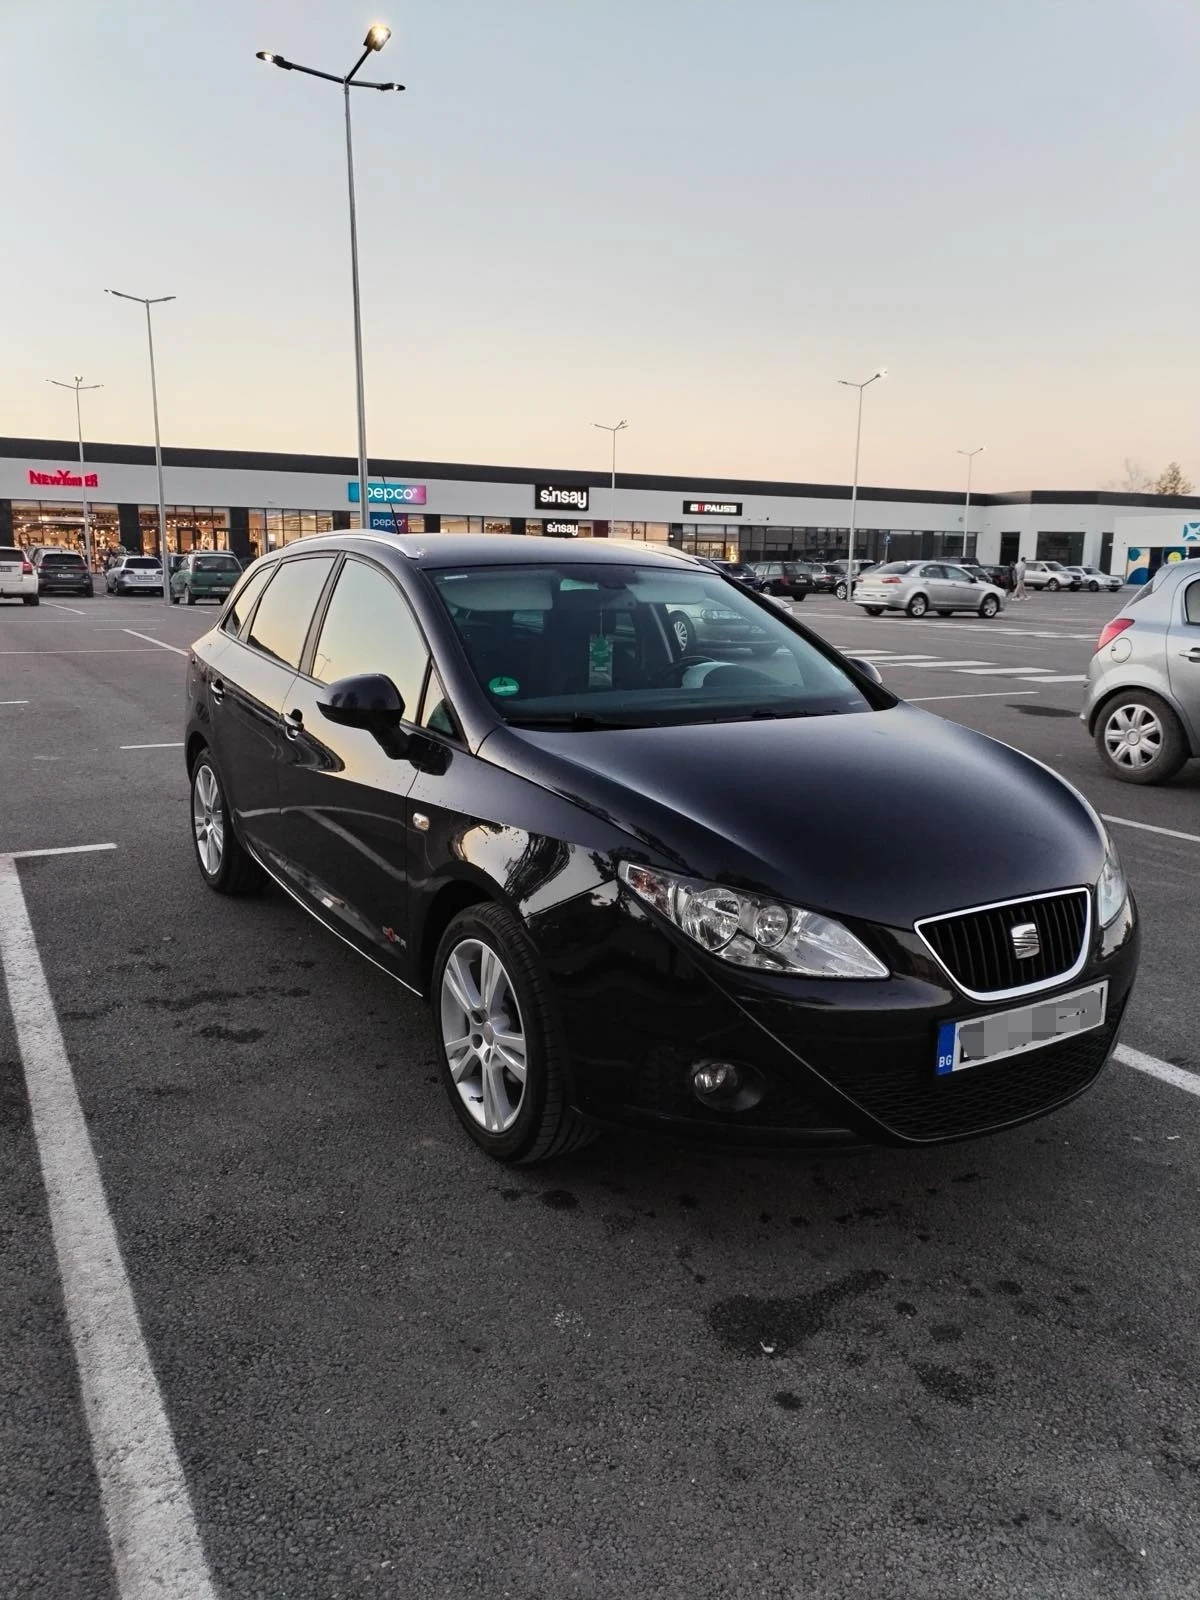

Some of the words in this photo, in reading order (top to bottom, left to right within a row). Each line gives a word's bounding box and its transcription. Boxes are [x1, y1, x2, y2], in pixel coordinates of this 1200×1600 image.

[540, 486, 587, 508] sinsay
[547, 522, 578, 536] sinsay
[939, 1055, 952, 1067] BG
